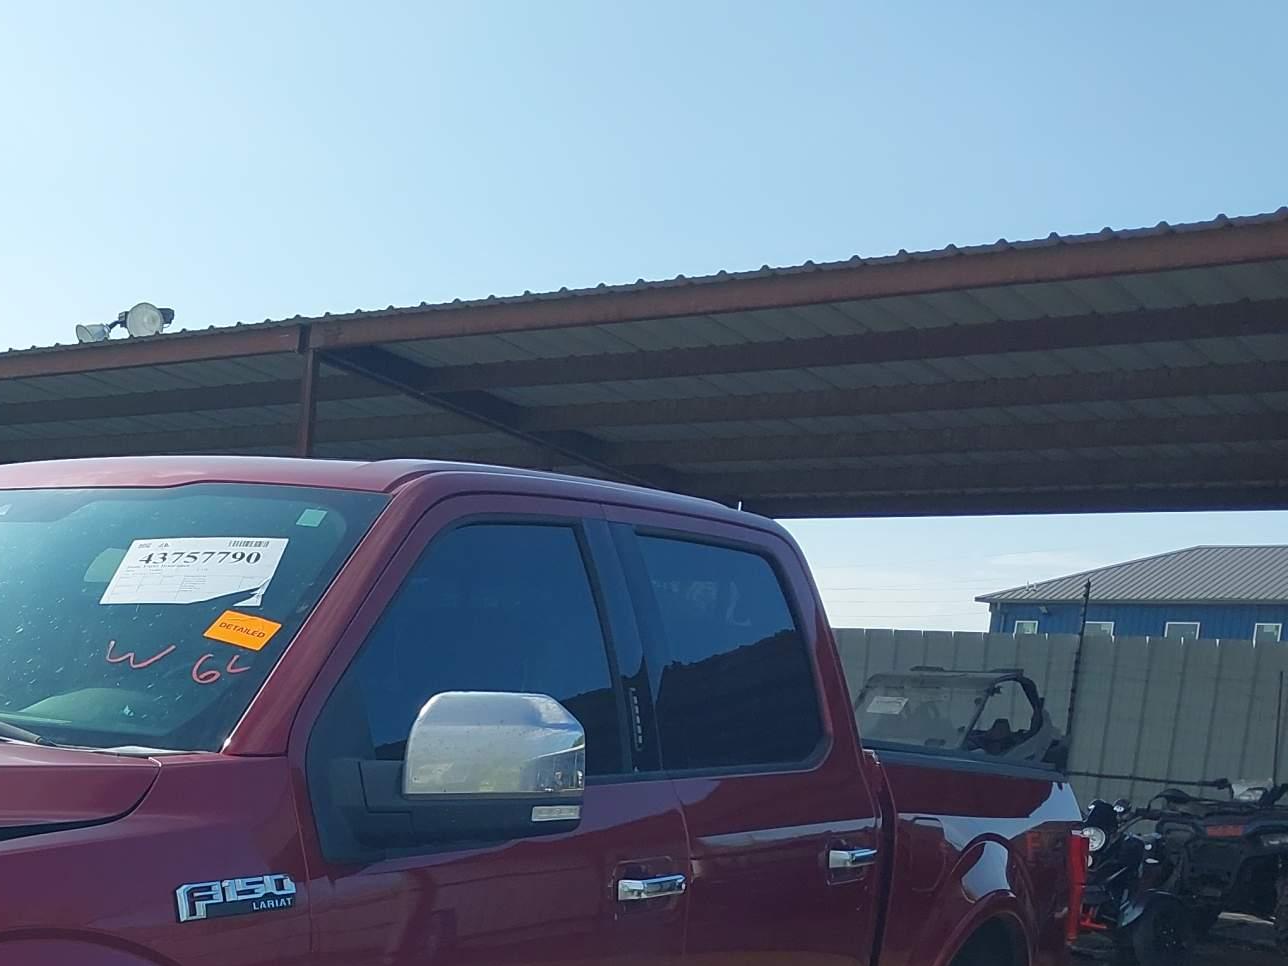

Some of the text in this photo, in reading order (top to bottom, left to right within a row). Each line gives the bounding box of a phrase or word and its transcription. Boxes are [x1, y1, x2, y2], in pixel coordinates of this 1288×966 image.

[139, 551, 262, 565] 43757790
[219, 622, 266, 639] DETAILED
[105, 640, 176, 669] W
[253, 897, 293, 910] LARIAT
